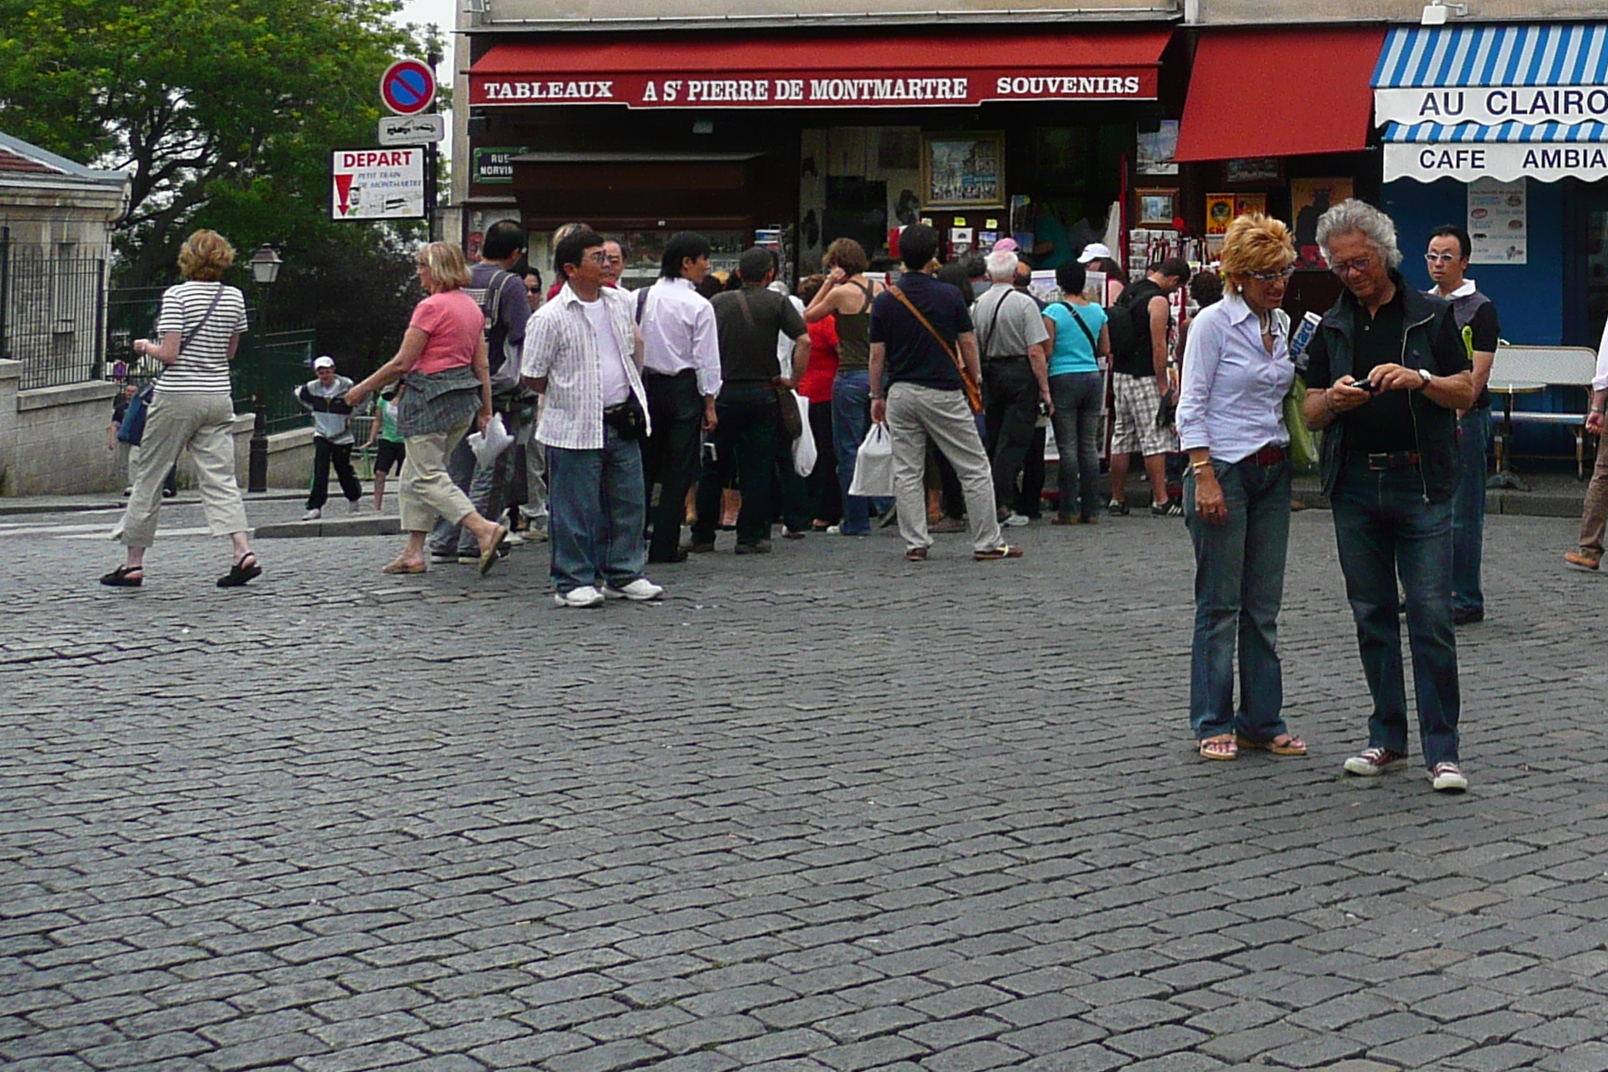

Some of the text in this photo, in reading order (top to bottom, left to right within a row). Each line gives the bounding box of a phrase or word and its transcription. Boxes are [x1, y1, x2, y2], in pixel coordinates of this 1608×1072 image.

[484, 81, 614, 99] TABLEAUX
[642, 81, 658, 101] A
[687, 80, 768, 101] PIERRE
[774, 80, 803, 100] DE
[809, 78, 968, 100] MONTMARTRE
[996, 76, 1140, 94] SOUVENIRS
[1419, 91, 1464, 116] AU
[343, 150, 413, 168] DEPART
[491, 154, 510, 163] RUE
[1419, 148, 1486, 169] CAFE
[480, 165, 514, 175] NORVIN
